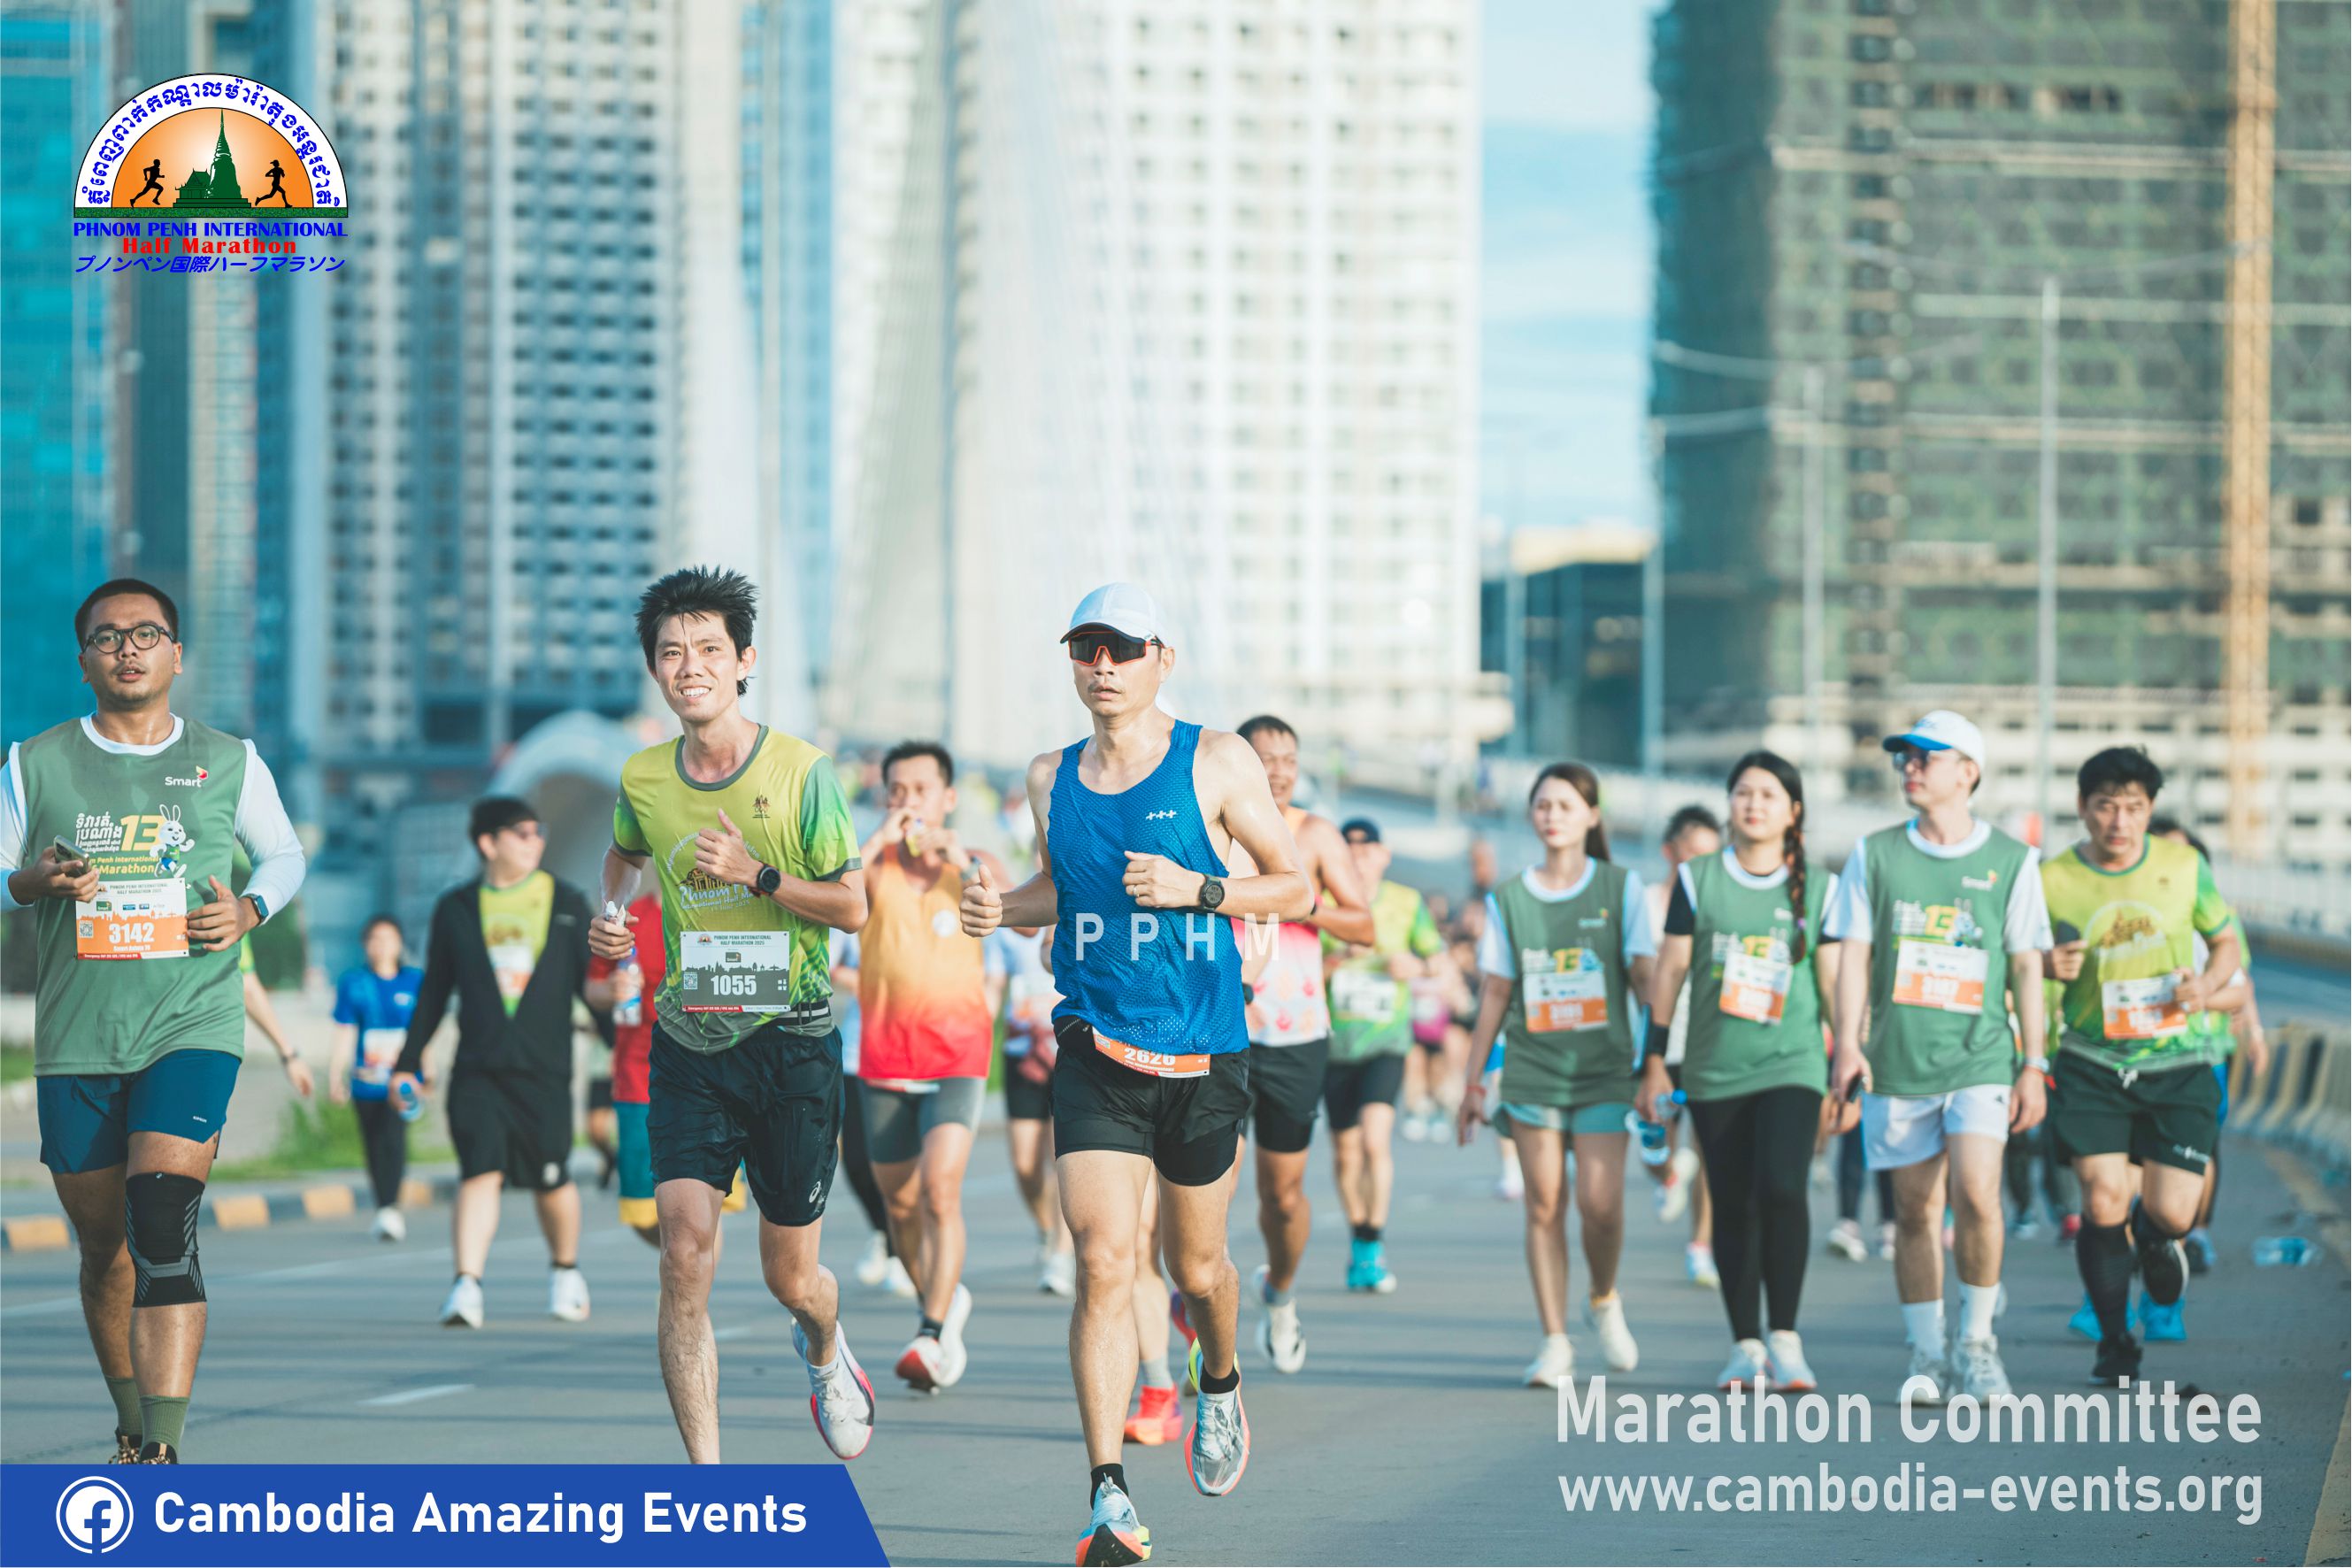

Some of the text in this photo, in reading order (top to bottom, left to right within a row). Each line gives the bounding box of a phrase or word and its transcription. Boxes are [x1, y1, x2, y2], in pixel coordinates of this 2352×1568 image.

[165, 776, 202, 788] Smart
[120, 815, 165, 851] 13
[115, 855, 158, 864] International
[99, 864, 155, 874] Marathon
[109, 922, 155, 944] 3142
[711, 975, 757, 995] 1055
